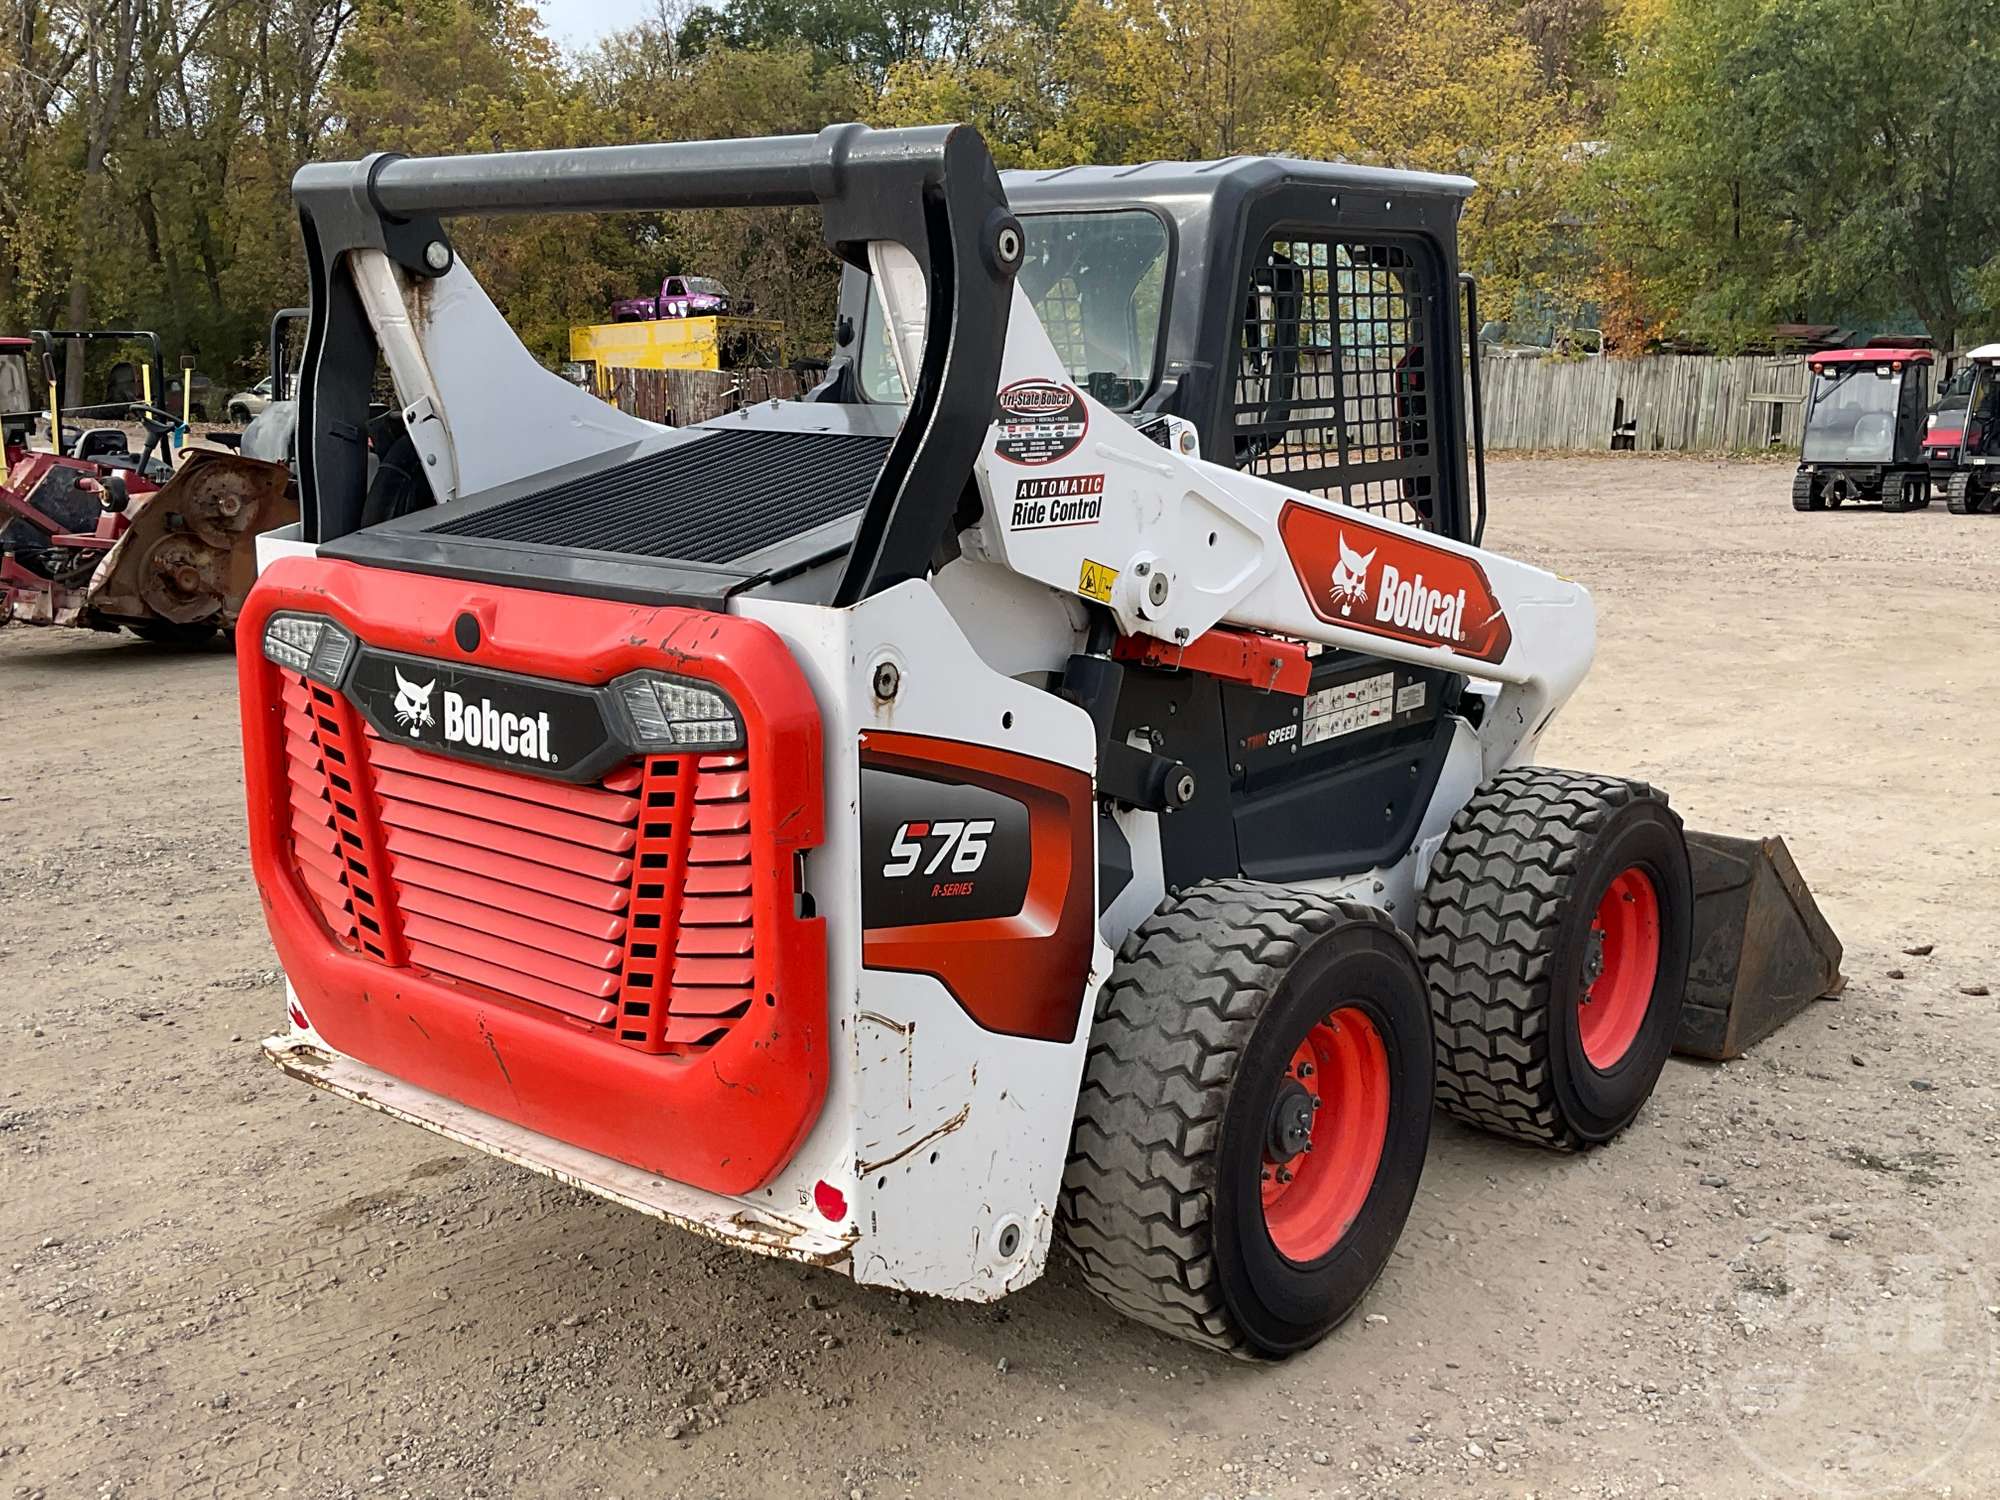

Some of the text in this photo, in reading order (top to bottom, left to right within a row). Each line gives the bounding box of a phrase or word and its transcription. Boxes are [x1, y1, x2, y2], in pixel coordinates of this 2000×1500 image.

[1002, 390, 1070, 406] Tri-State Bobcat
[1019, 477, 1102, 497] AUTOMATIC
[1011, 496, 1102, 526] Ride Control
[1375, 564, 1465, 641] Bobcat
[443, 690, 551, 763] Bobcat
[1267, 724, 1298, 746] SPEED
[882, 820, 996, 878] S76
[931, 882, 975, 897] R-SERIES
